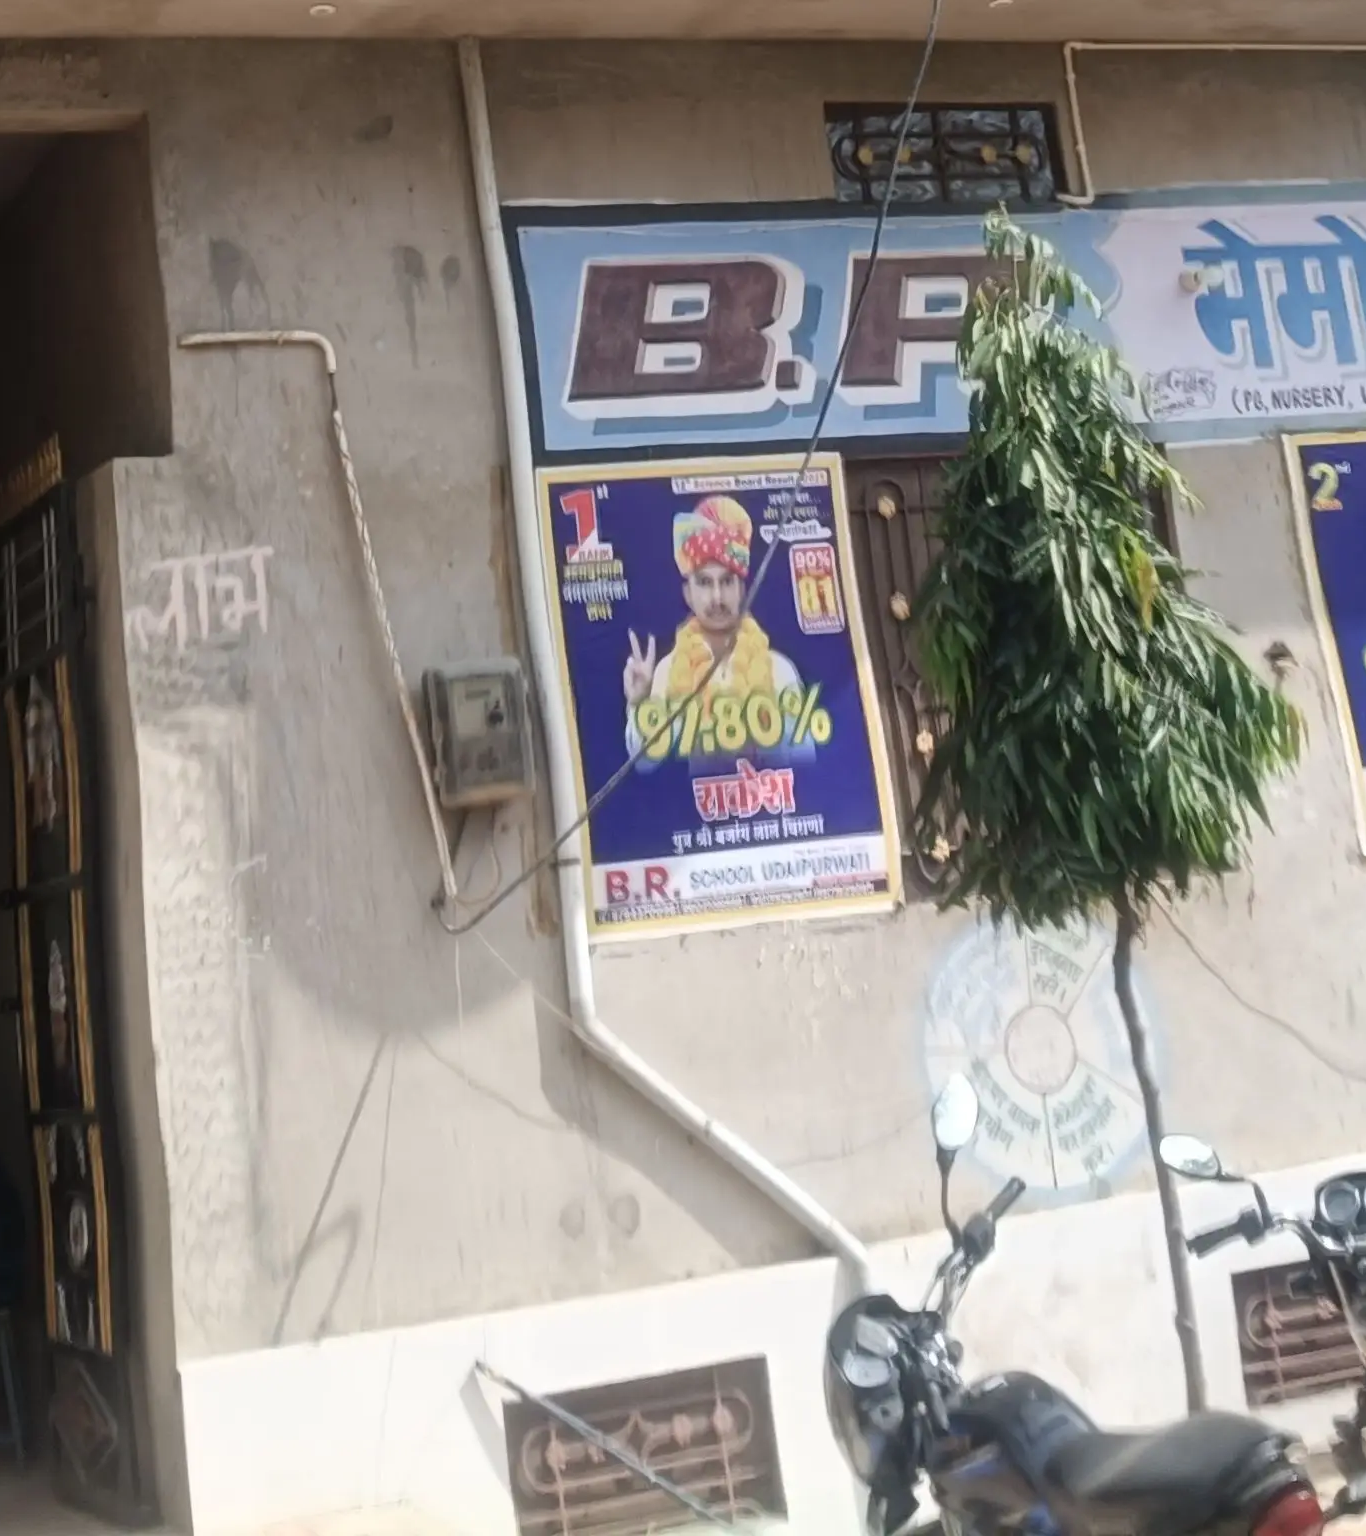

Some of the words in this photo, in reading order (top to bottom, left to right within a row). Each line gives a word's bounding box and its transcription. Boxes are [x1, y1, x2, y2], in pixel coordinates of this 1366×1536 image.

[734, 476, 763, 488] Board
[692, 758, 797, 822] राकेश
[605, 865, 682, 904] B.R.
[689, 865, 756, 891] SCHOOL
[761, 852, 872, 883] UDAIPURWATI
